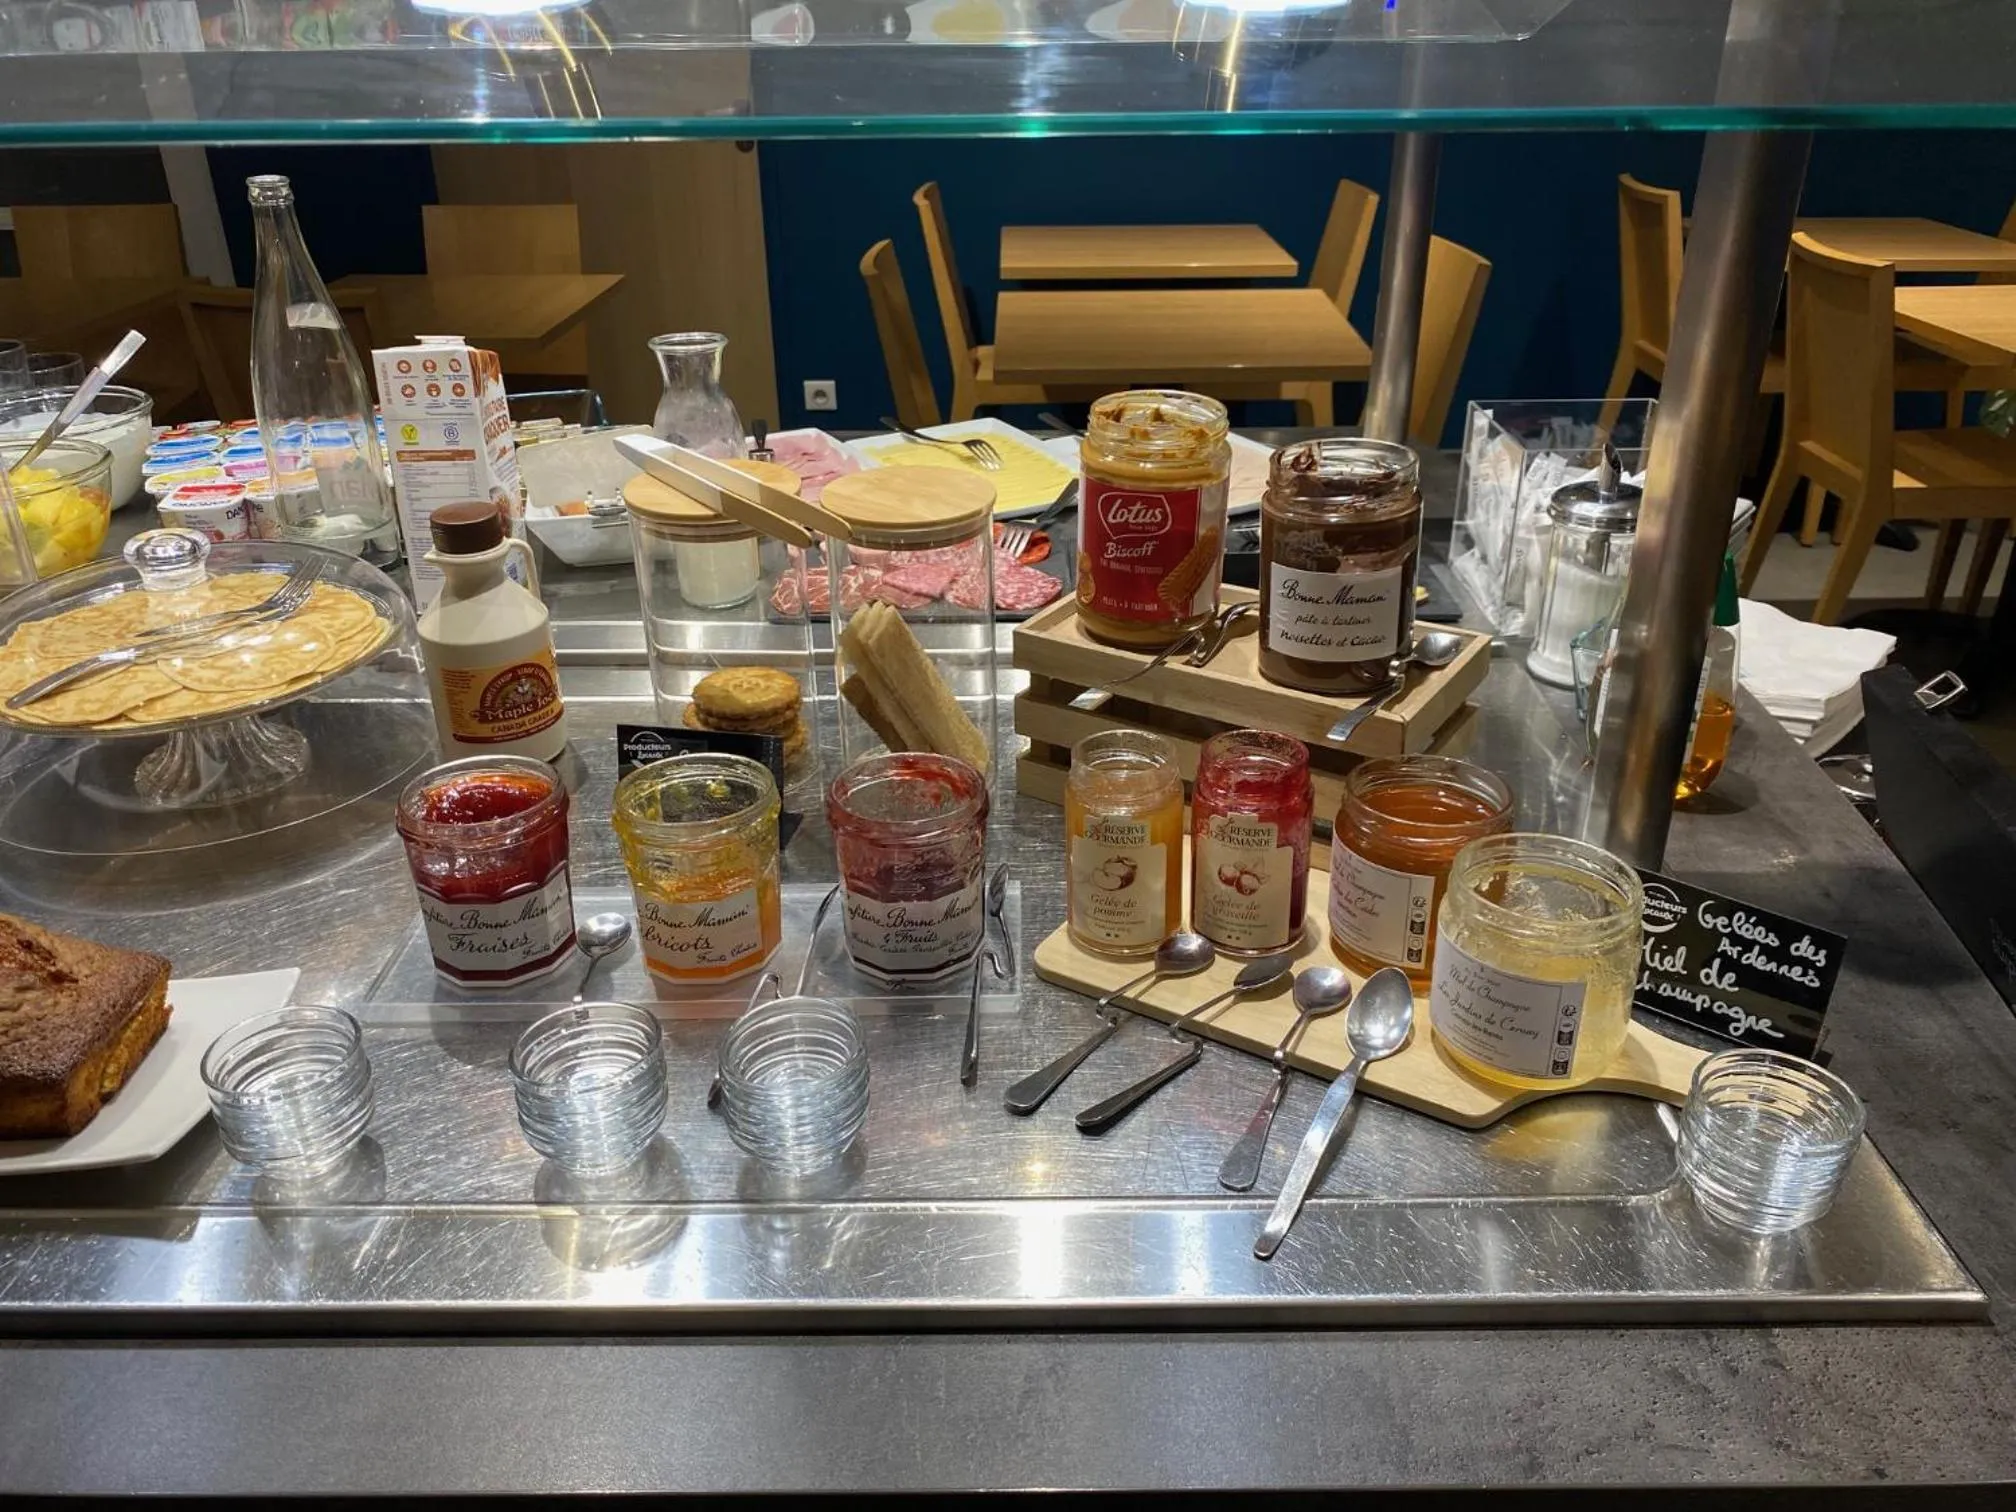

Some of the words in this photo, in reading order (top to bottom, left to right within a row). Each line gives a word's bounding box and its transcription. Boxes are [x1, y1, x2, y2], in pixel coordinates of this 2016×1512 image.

[1107, 499, 1163, 523] Lotus
[1104, 541, 1157, 559] Biscoff
[1281, 579, 1325, 605] Bonne
[1326, 584, 1387, 605] Maman
[486, 704, 533, 720] Maple
[458, 908, 512, 930] Bonne
[645, 902, 686, 929] Bonne
[886, 907, 936, 929] Bonne
[448, 931, 532, 954] Fraises
[641, 925, 716, 952] bricots
[1698, 900, 1780, 947] Gelées
[1790, 935, 1826, 967] des
[1700, 958, 1740, 992] de
[1718, 937, 1820, 987] Ardennes
[1635, 970, 1786, 1037] hampagne
